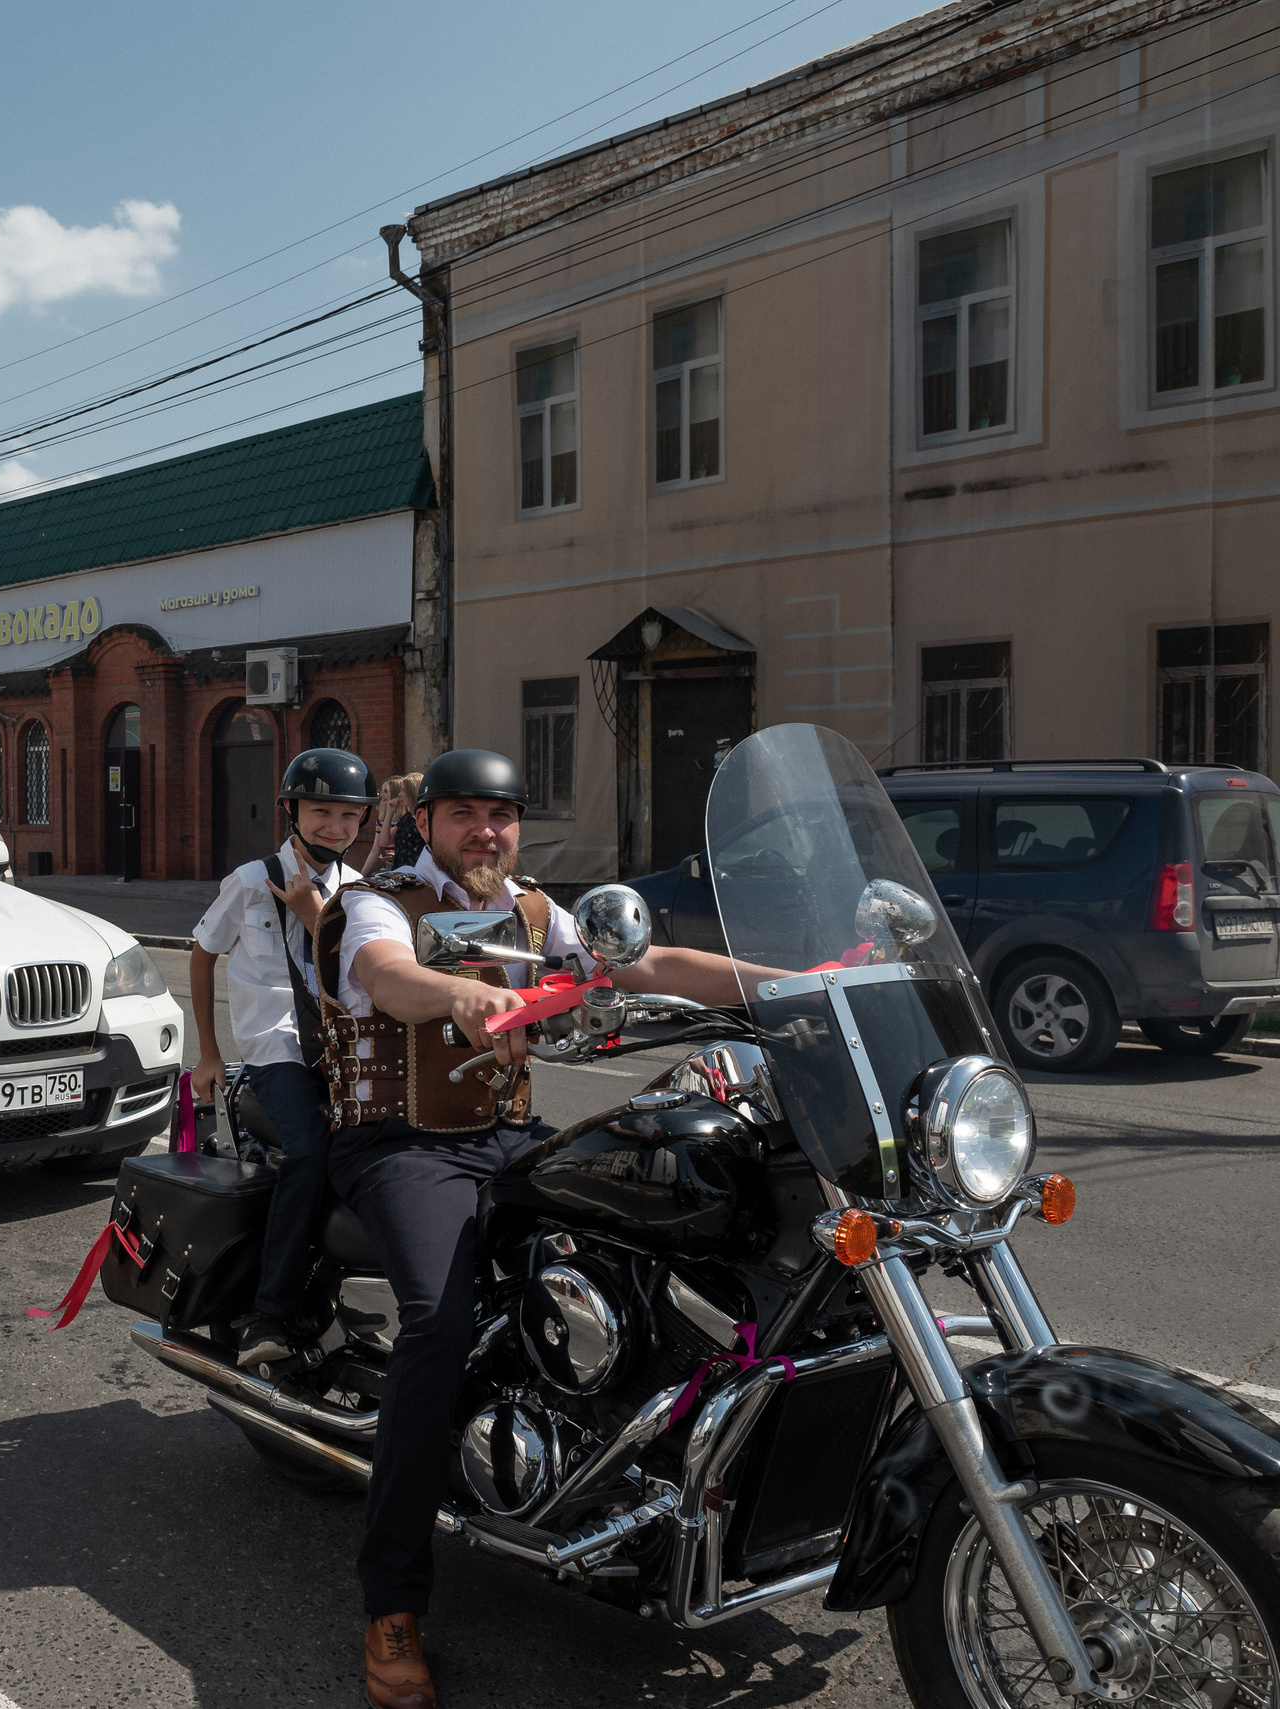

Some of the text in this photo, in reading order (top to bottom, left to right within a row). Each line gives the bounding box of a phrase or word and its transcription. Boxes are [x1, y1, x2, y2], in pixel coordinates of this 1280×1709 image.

[159, 585, 257, 611] Магазин у дома
[47, 1073, 78, 1095] 750
[54, 1092, 71, 1101] RUS
